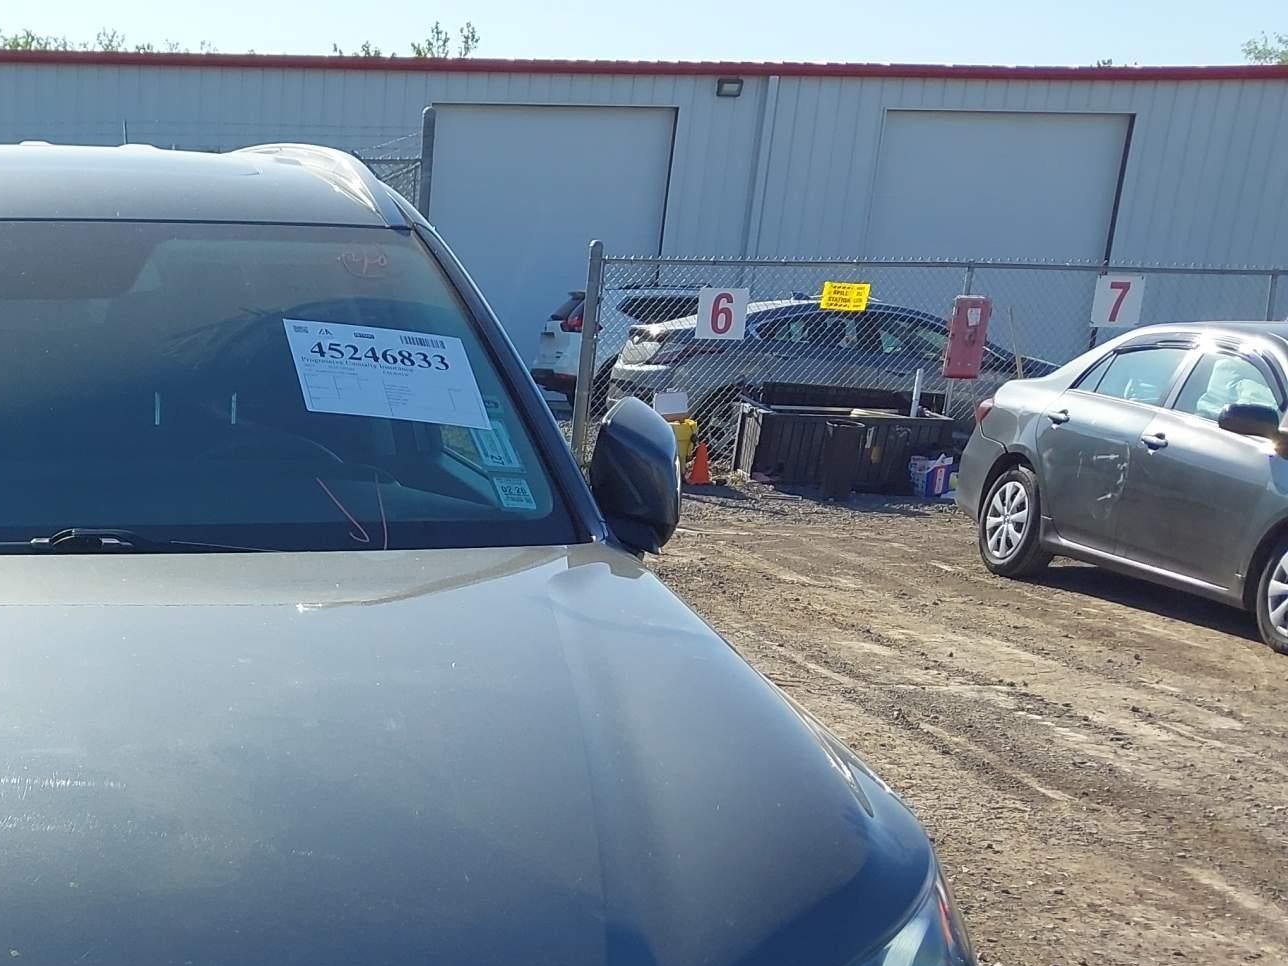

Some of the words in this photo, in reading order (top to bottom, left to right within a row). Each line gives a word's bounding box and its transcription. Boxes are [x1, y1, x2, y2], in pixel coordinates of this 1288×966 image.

[711, 292, 734, 335] 6
[1108, 281, 1131, 322] 7
[310, 341, 450, 371] 45246833
